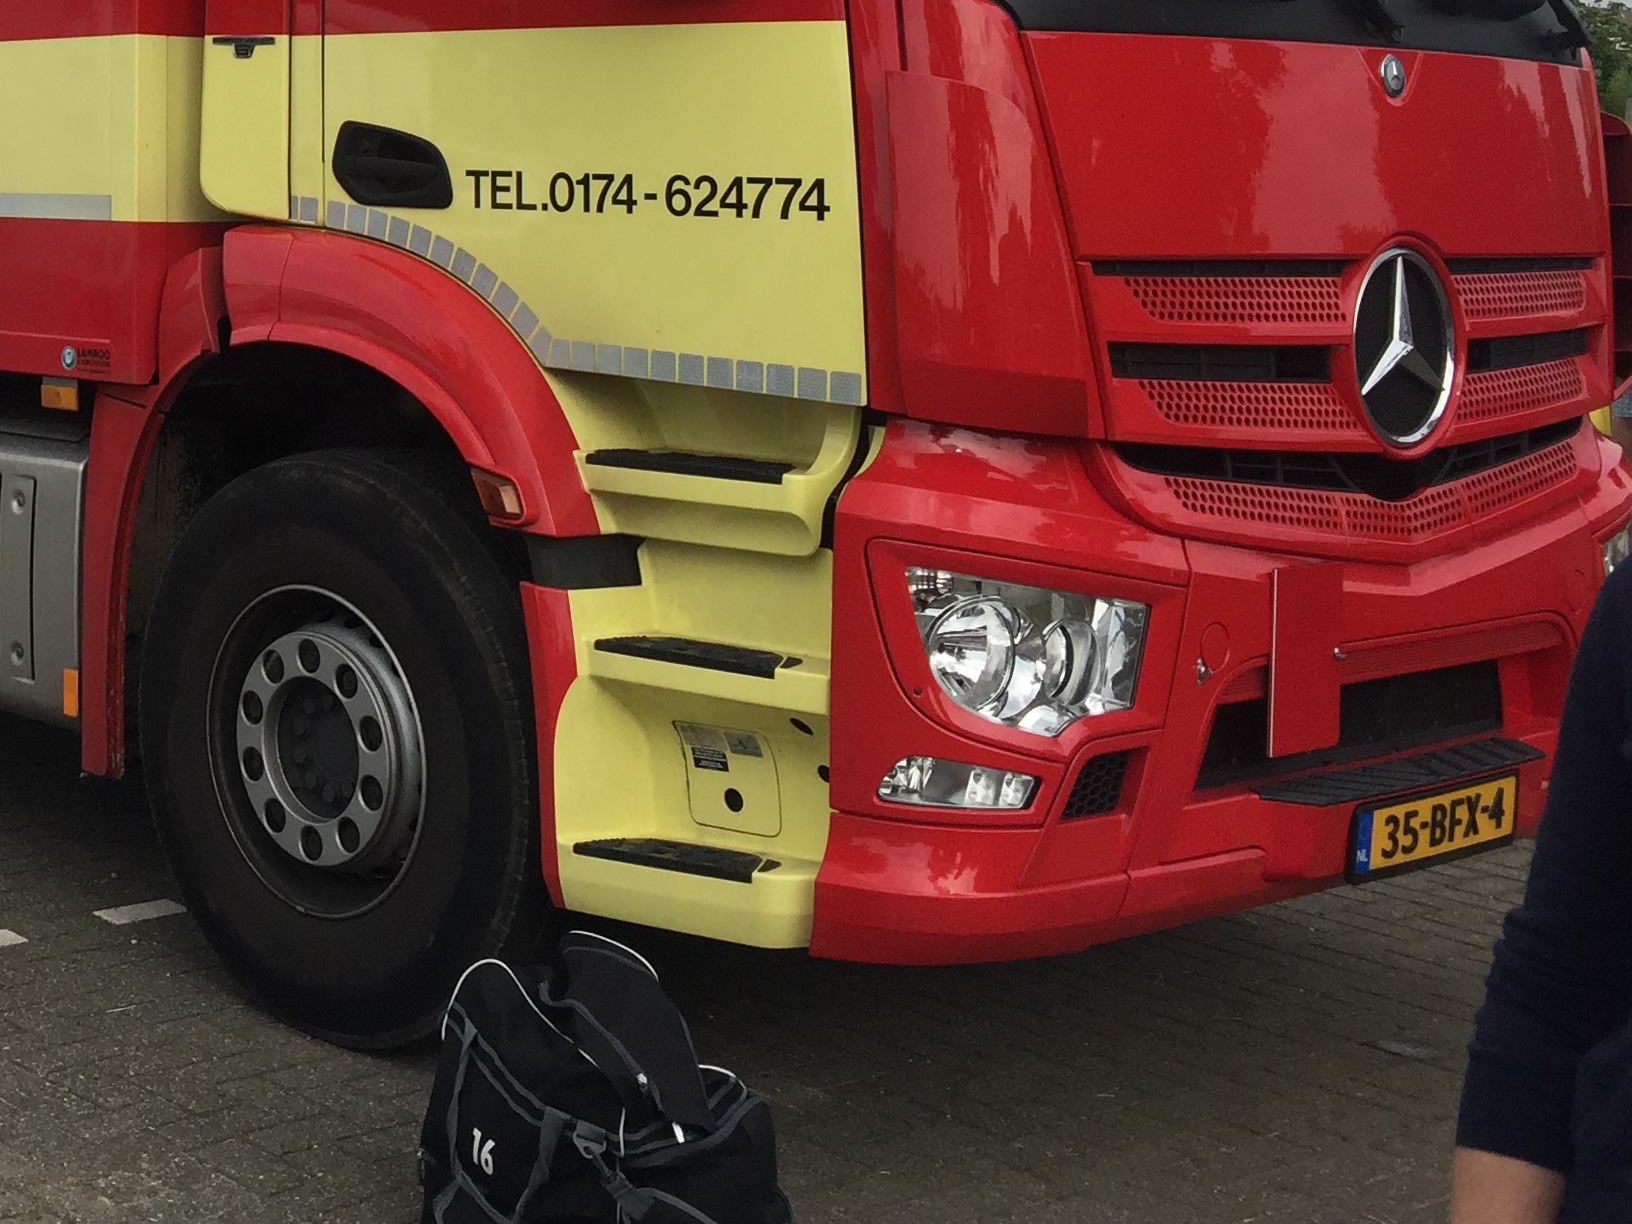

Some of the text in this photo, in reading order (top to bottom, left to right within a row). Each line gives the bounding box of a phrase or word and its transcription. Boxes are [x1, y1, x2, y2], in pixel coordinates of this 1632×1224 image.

[1381, 787, 1505, 859] 35-BFX-4
[1356, 849, 1368, 863] NL
[473, 1127, 496, 1175] 16
